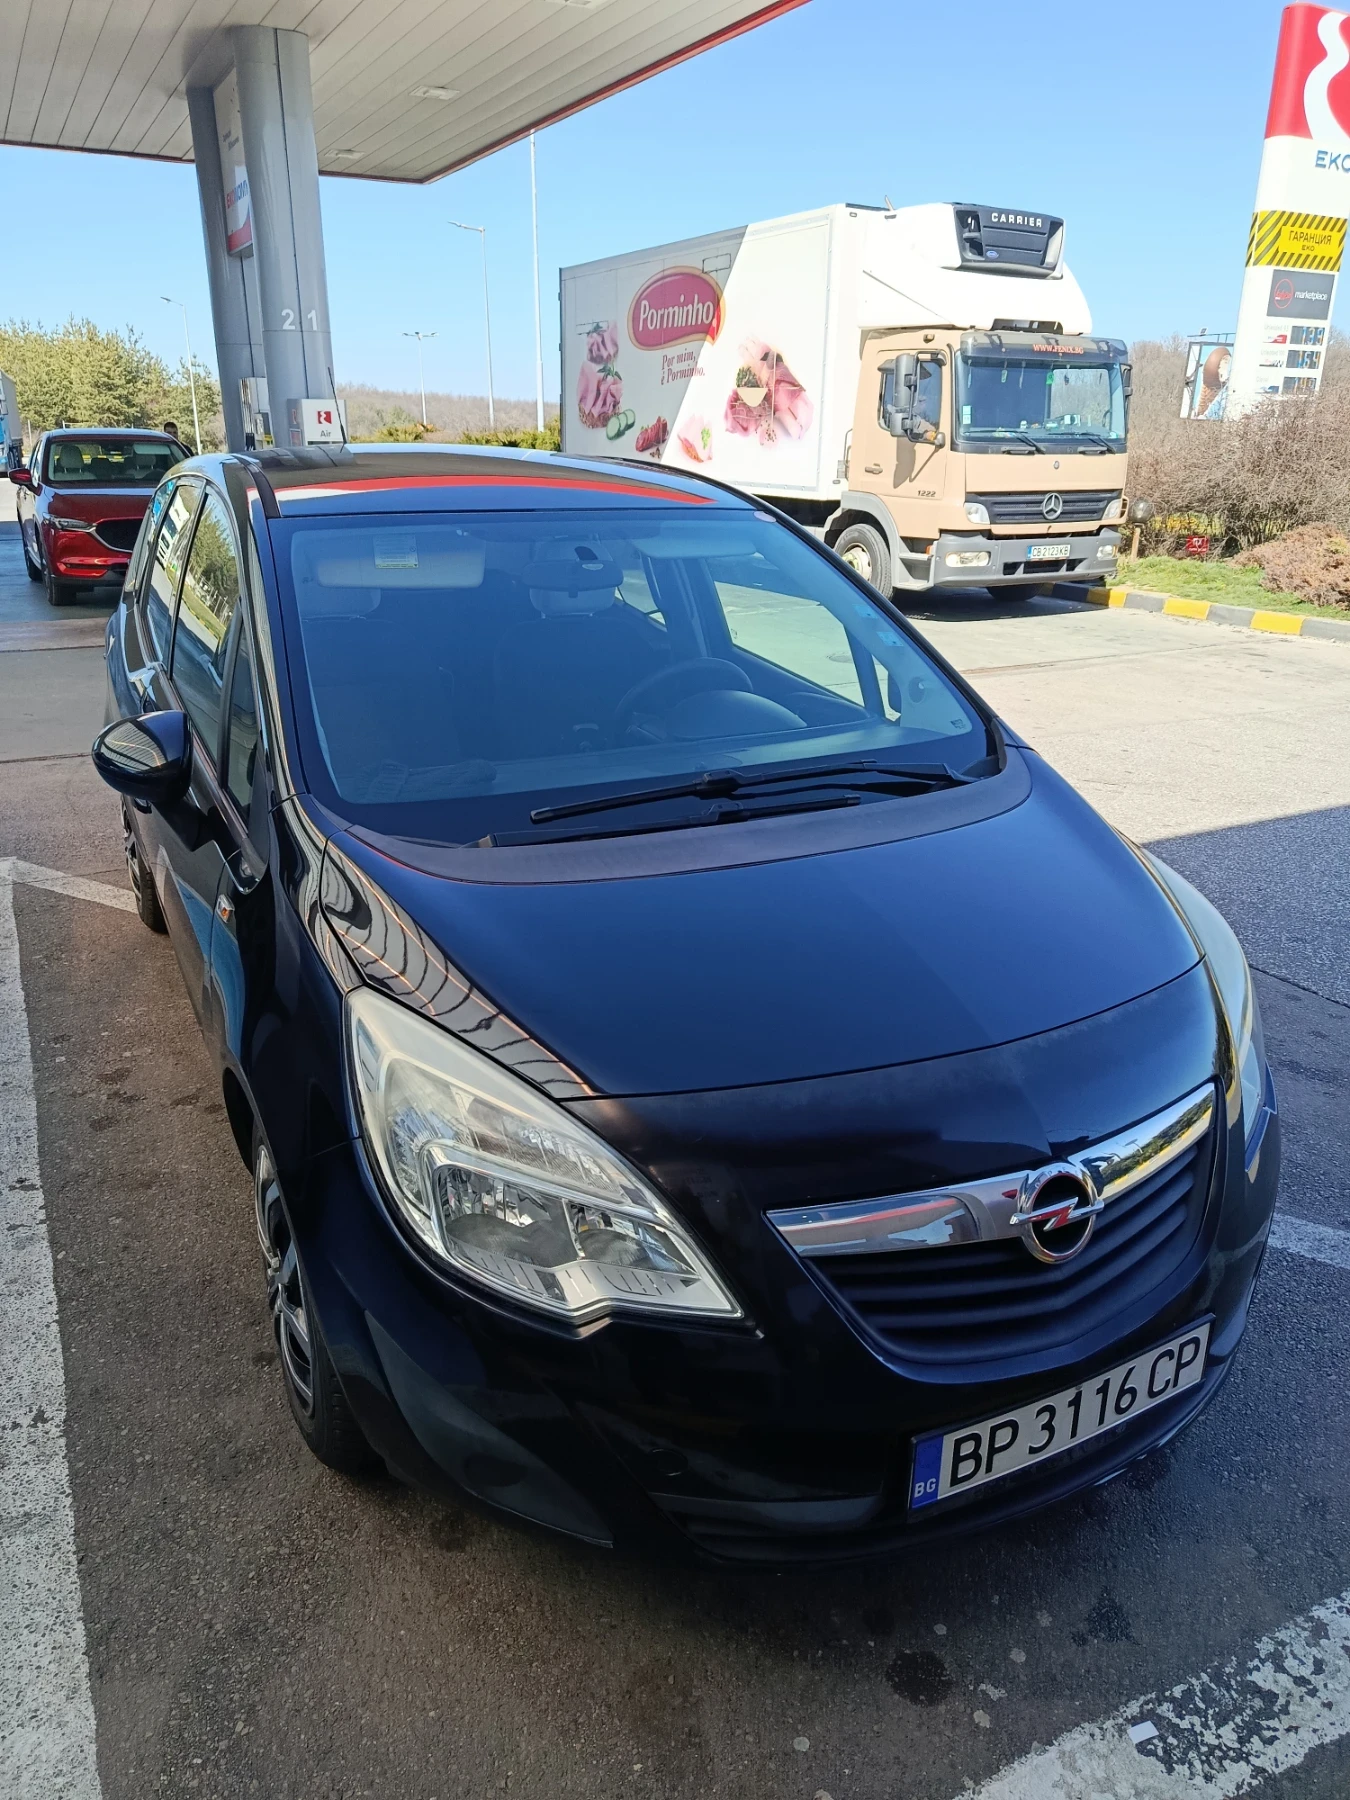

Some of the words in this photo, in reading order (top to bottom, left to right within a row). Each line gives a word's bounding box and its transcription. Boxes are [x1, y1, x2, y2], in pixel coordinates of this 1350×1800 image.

[991, 212, 1042, 228] CARRIER
[1289, 230, 1332, 245] ГАРАНЦИЯ
[281, 309, 296, 330] 2
[307, 309, 318, 331] 1
[639, 293, 714, 331] Porminho
[662, 354, 675, 370] Por
[676, 348, 696, 364] mim,
[667, 362, 705, 383] Porminho.
[320, 430, 331, 438] Air
[1042, 547, 1059, 556] 2123
[950, 1418, 1019, 1487] BP
[1028, 1364, 1138, 1455] 3116
[1147, 1335, 1201, 1399] CP
[914, 1477, 936, 1498] BG
